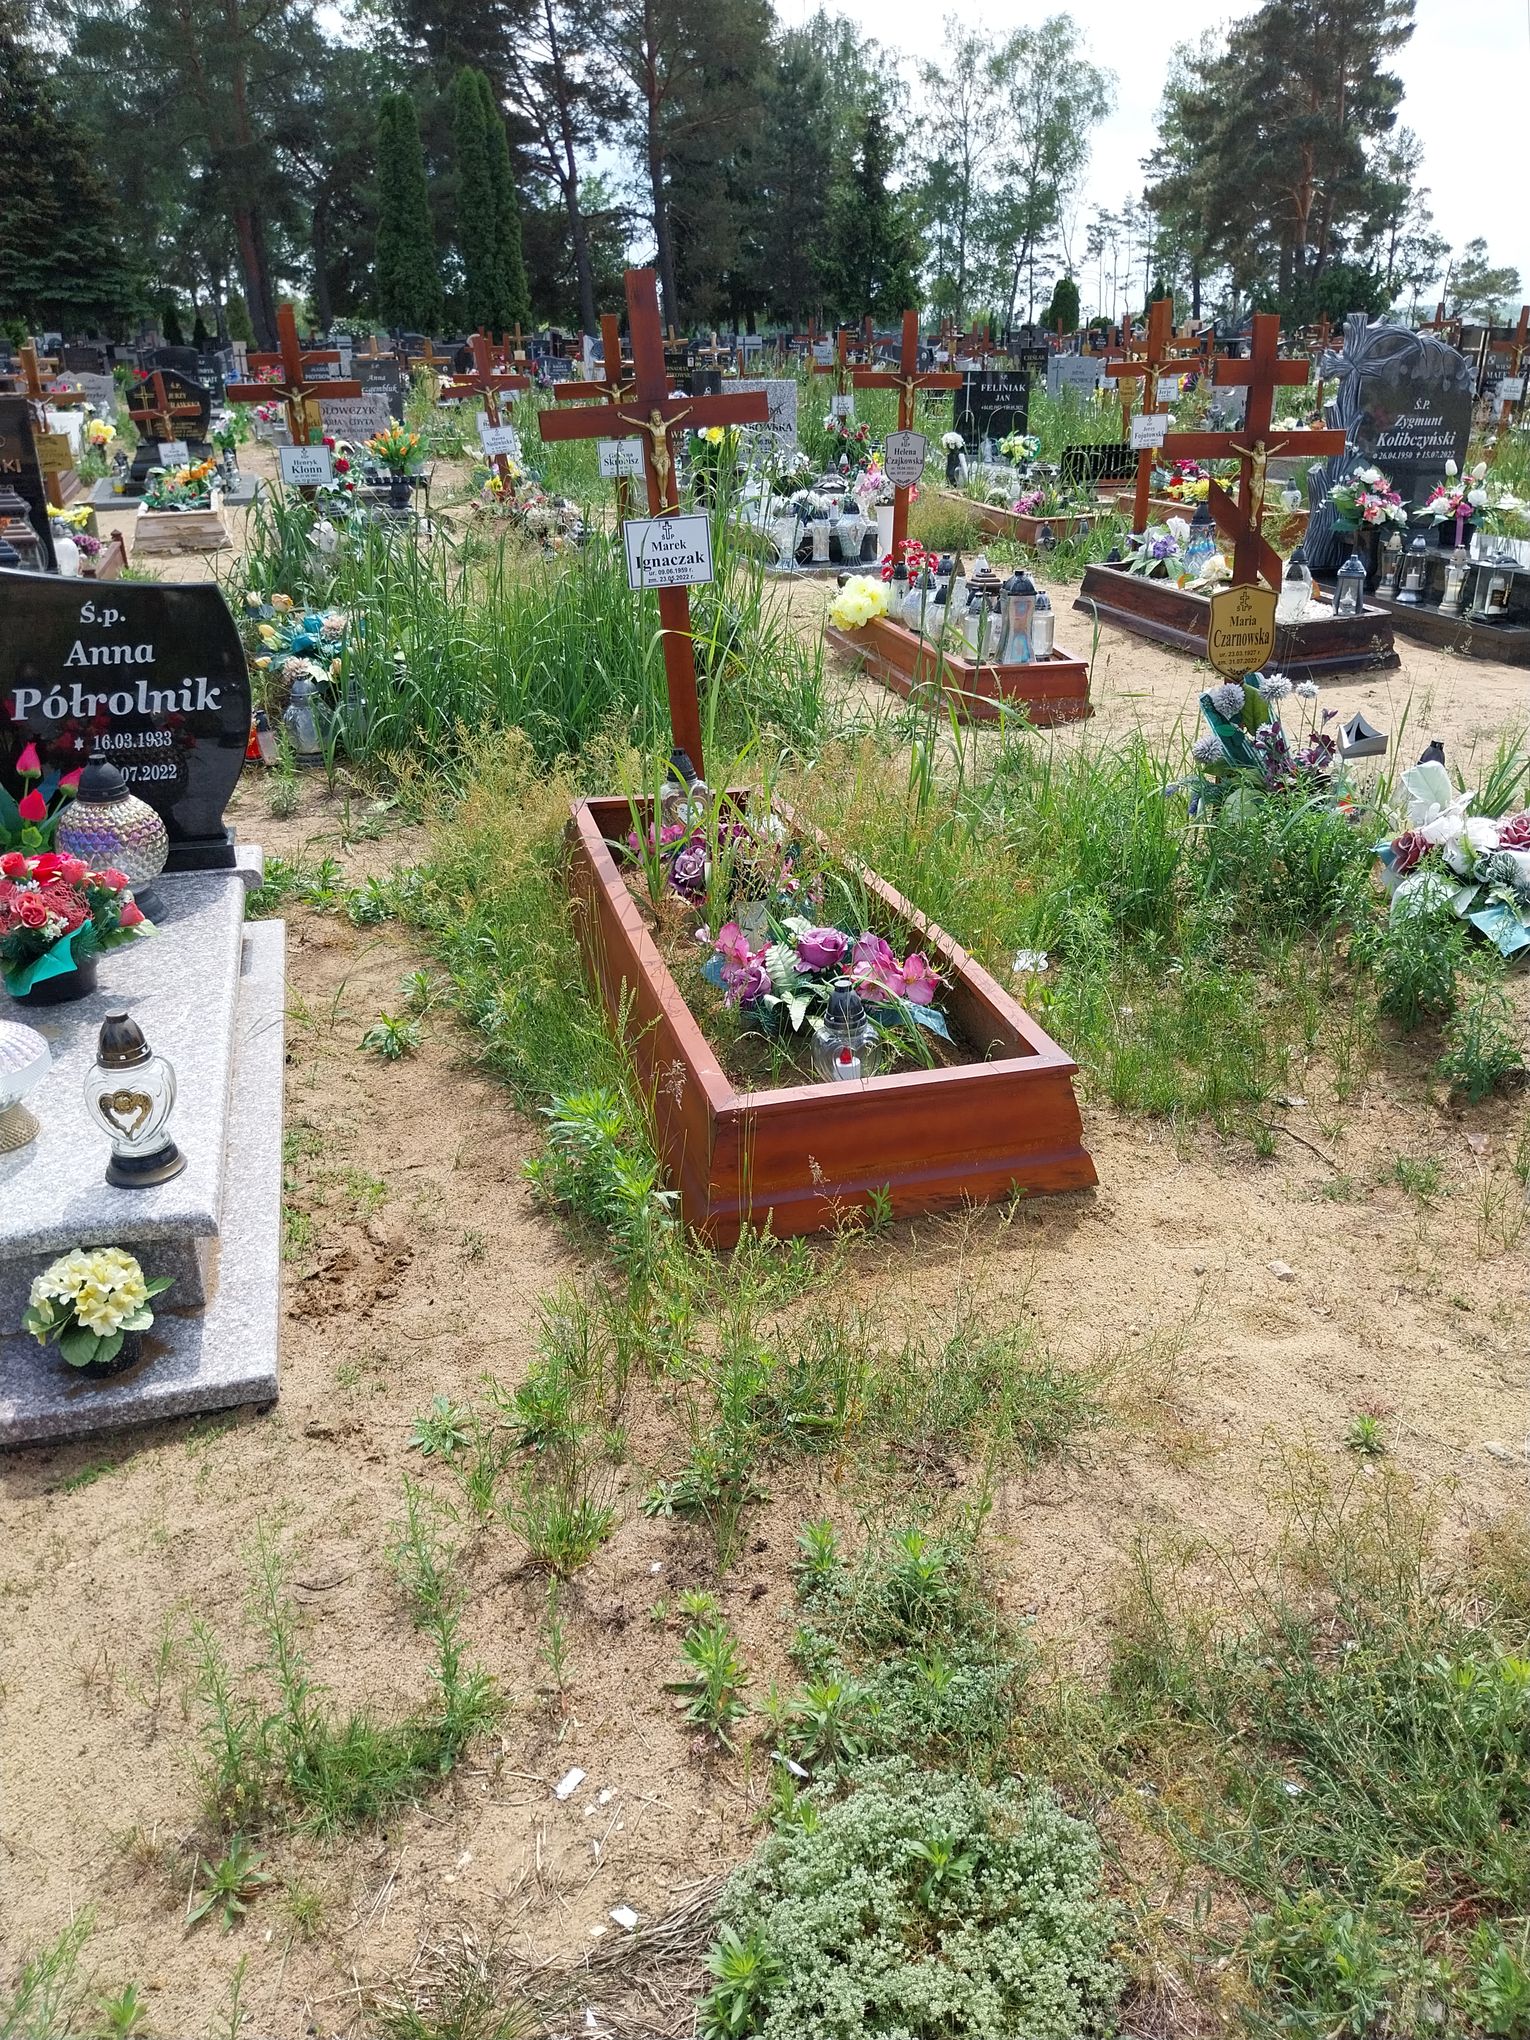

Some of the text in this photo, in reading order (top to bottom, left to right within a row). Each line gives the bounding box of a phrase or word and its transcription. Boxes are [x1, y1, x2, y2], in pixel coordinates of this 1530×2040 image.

[980, 383, 1026, 392] FELINIAK
[995, 394, 1011, 402] JAN
[1413, 397, 1430, 410] Ś.P.
[1394, 414, 1443, 430] Zygmunt
[1375, 431, 1457, 450] Kolibczyński
[894, 447, 917, 456] Helena
[293, 459, 318, 467] Henryk
[886, 456, 924, 467] Czajkowska
[292, 465, 323, 474] Klonn
[651, 540, 688, 553] Marek
[635, 550, 706, 573] Ignaczak
[79, 600, 127, 628] Ś.p.
[1229, 614, 1257, 628] Maria
[1213, 627, 1270, 648] Czarnowska
[63, 639, 157, 667] Anna
[10, 676, 222, 722] Półrolnik
[93, 730, 173, 751] 16.03.1933
[120, 763, 178, 783] 07.2022
